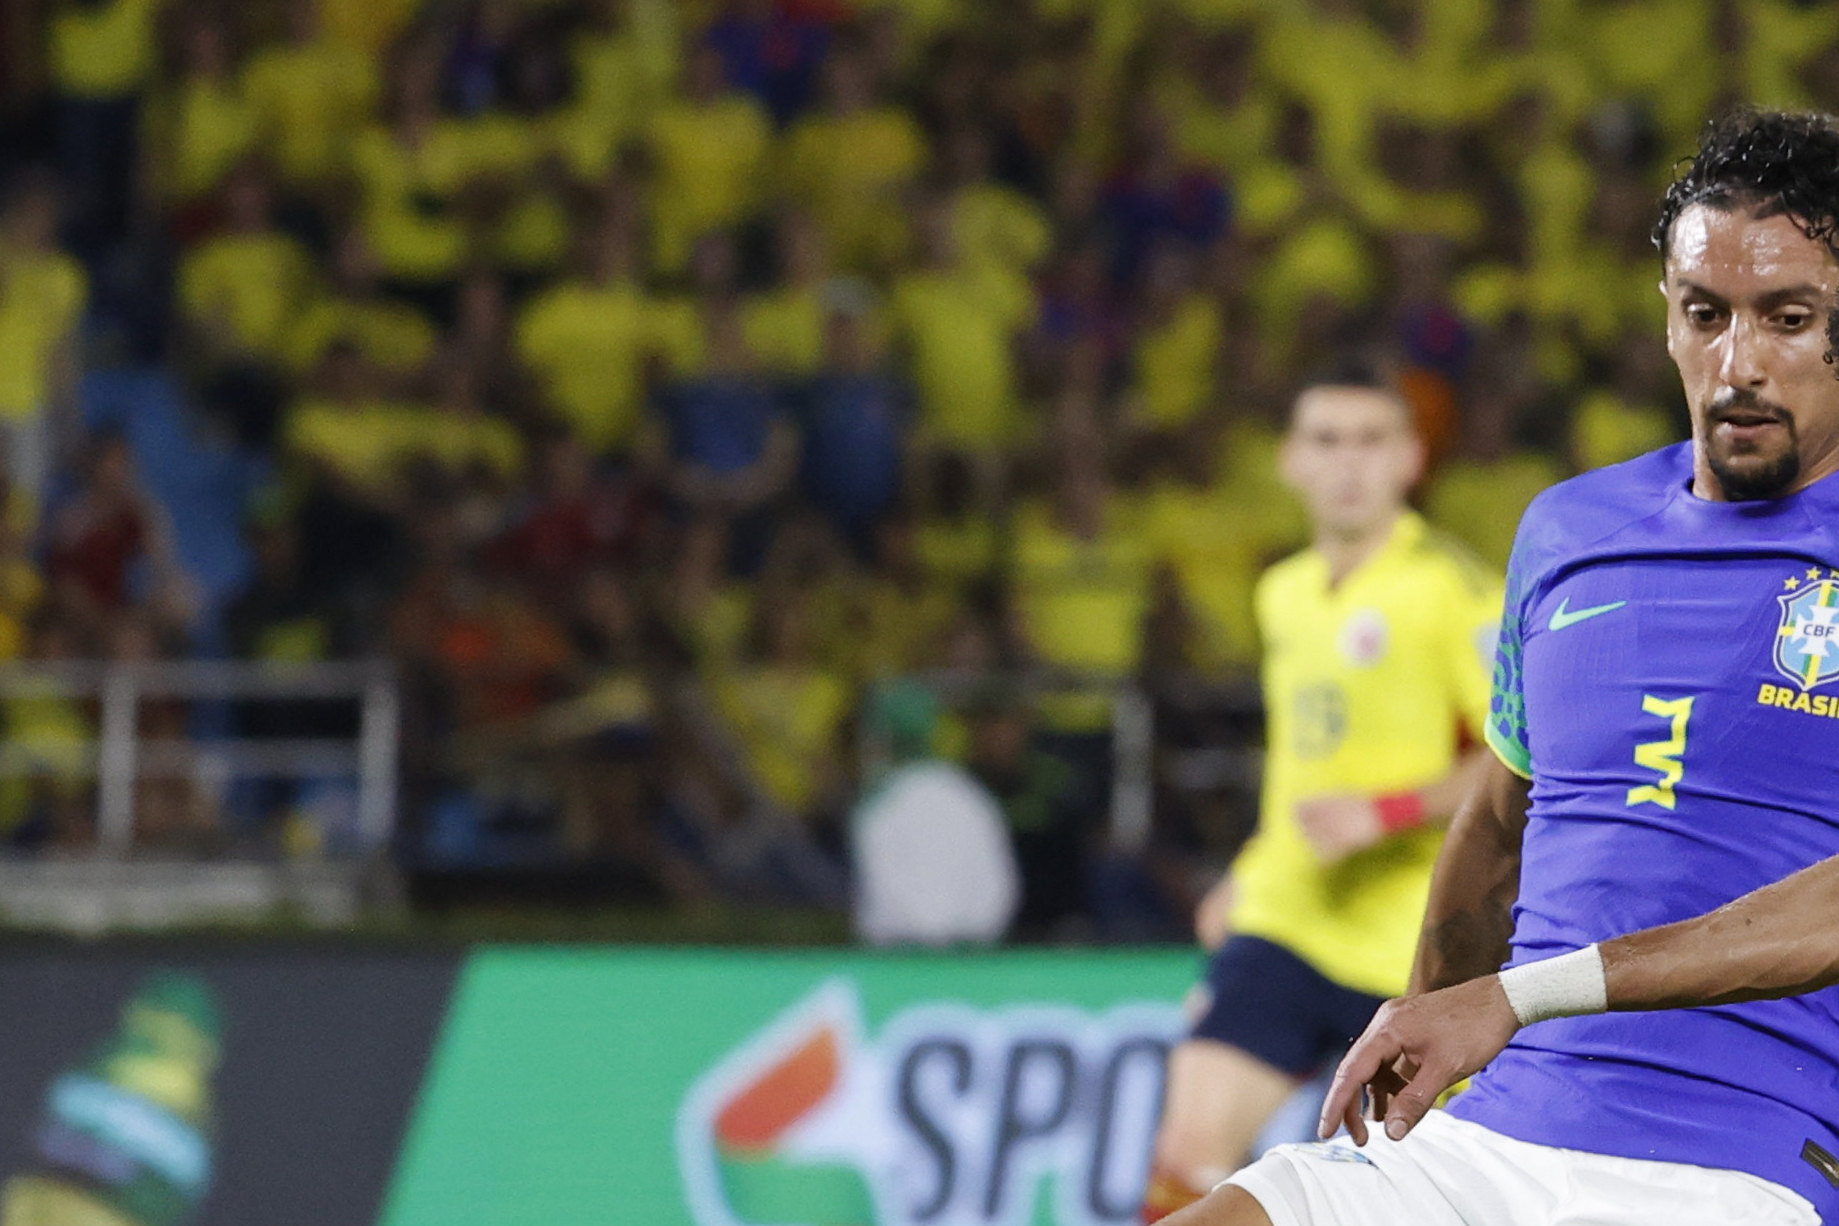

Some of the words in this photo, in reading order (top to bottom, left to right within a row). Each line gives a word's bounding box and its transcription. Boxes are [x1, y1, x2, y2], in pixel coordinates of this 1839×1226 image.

[1803, 624, 1836, 638] CBF
[1625, 693, 1696, 811] 3
[893, 1036, 1169, 1224] SPO
